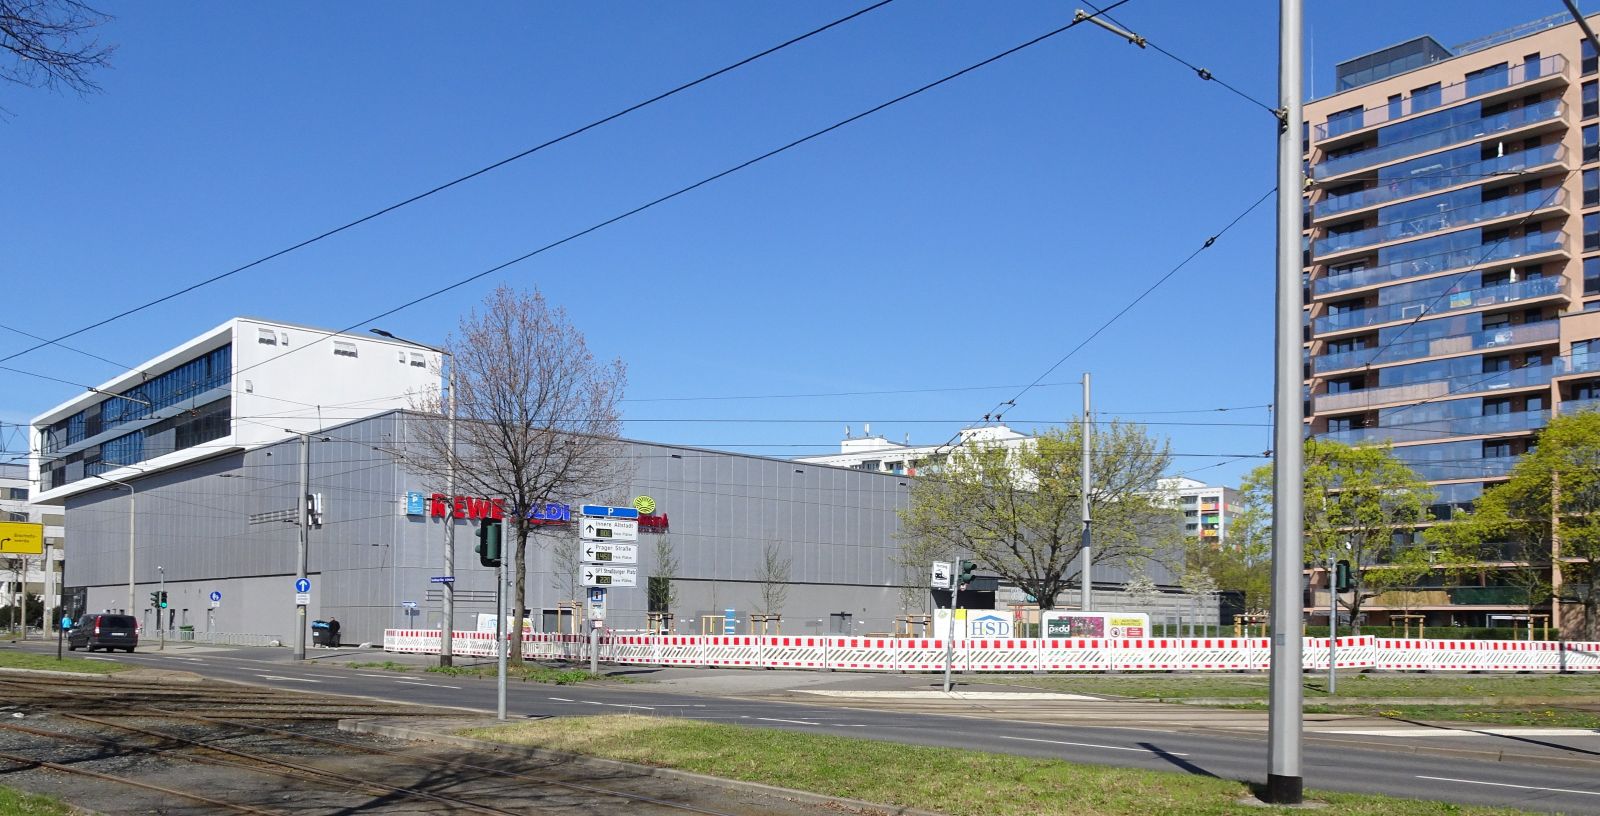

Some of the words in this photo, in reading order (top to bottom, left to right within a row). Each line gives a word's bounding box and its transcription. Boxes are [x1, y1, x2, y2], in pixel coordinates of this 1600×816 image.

[431, 493, 505, 519] REWE
[608, 507, 614, 516] P
[971, 622, 1010, 635] HSD
